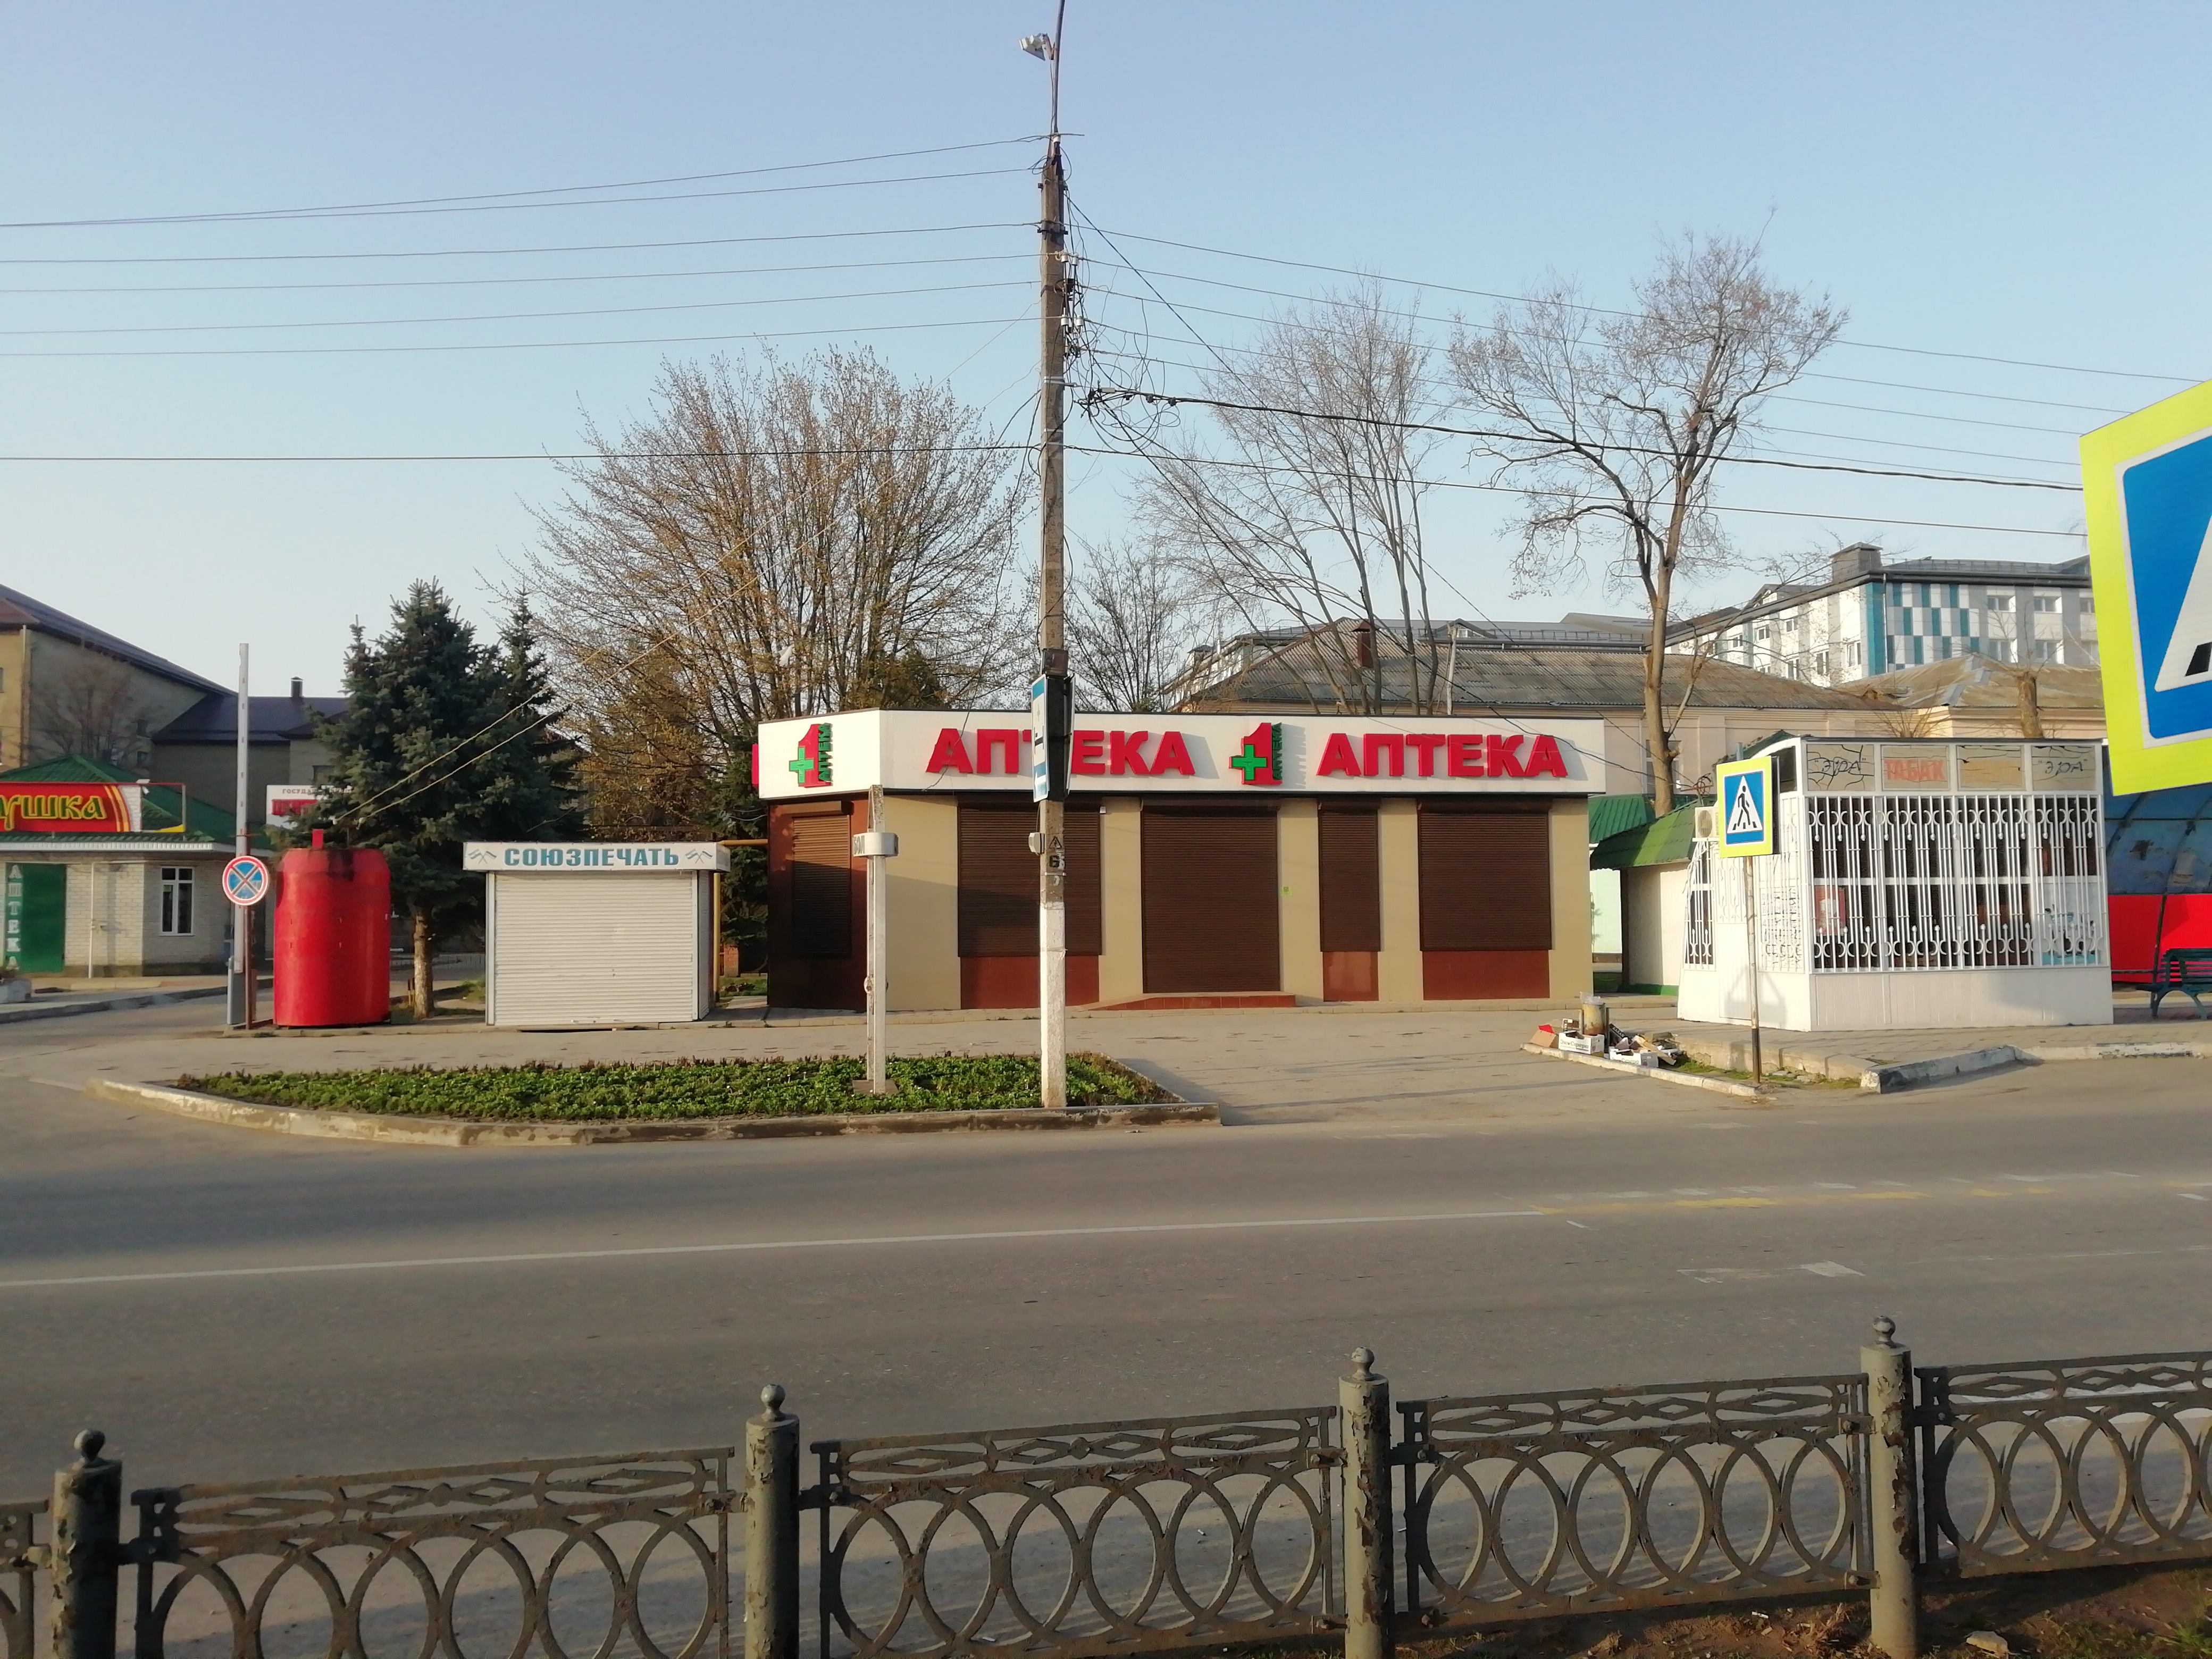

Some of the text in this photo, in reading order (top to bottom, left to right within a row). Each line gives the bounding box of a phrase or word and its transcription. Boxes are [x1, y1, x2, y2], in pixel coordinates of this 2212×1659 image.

[818, 723, 833, 782] АПТЕКА
[925, 728, 1196, 775] АПЕКА
[1316, 733, 1568, 777] АПТЕКА
[1884, 758, 1945, 781] ТАБАК
[504, 848, 679, 866] СОЮЗПЕЧАТЬ
[7, 865, 23, 971] АПТЕКА
